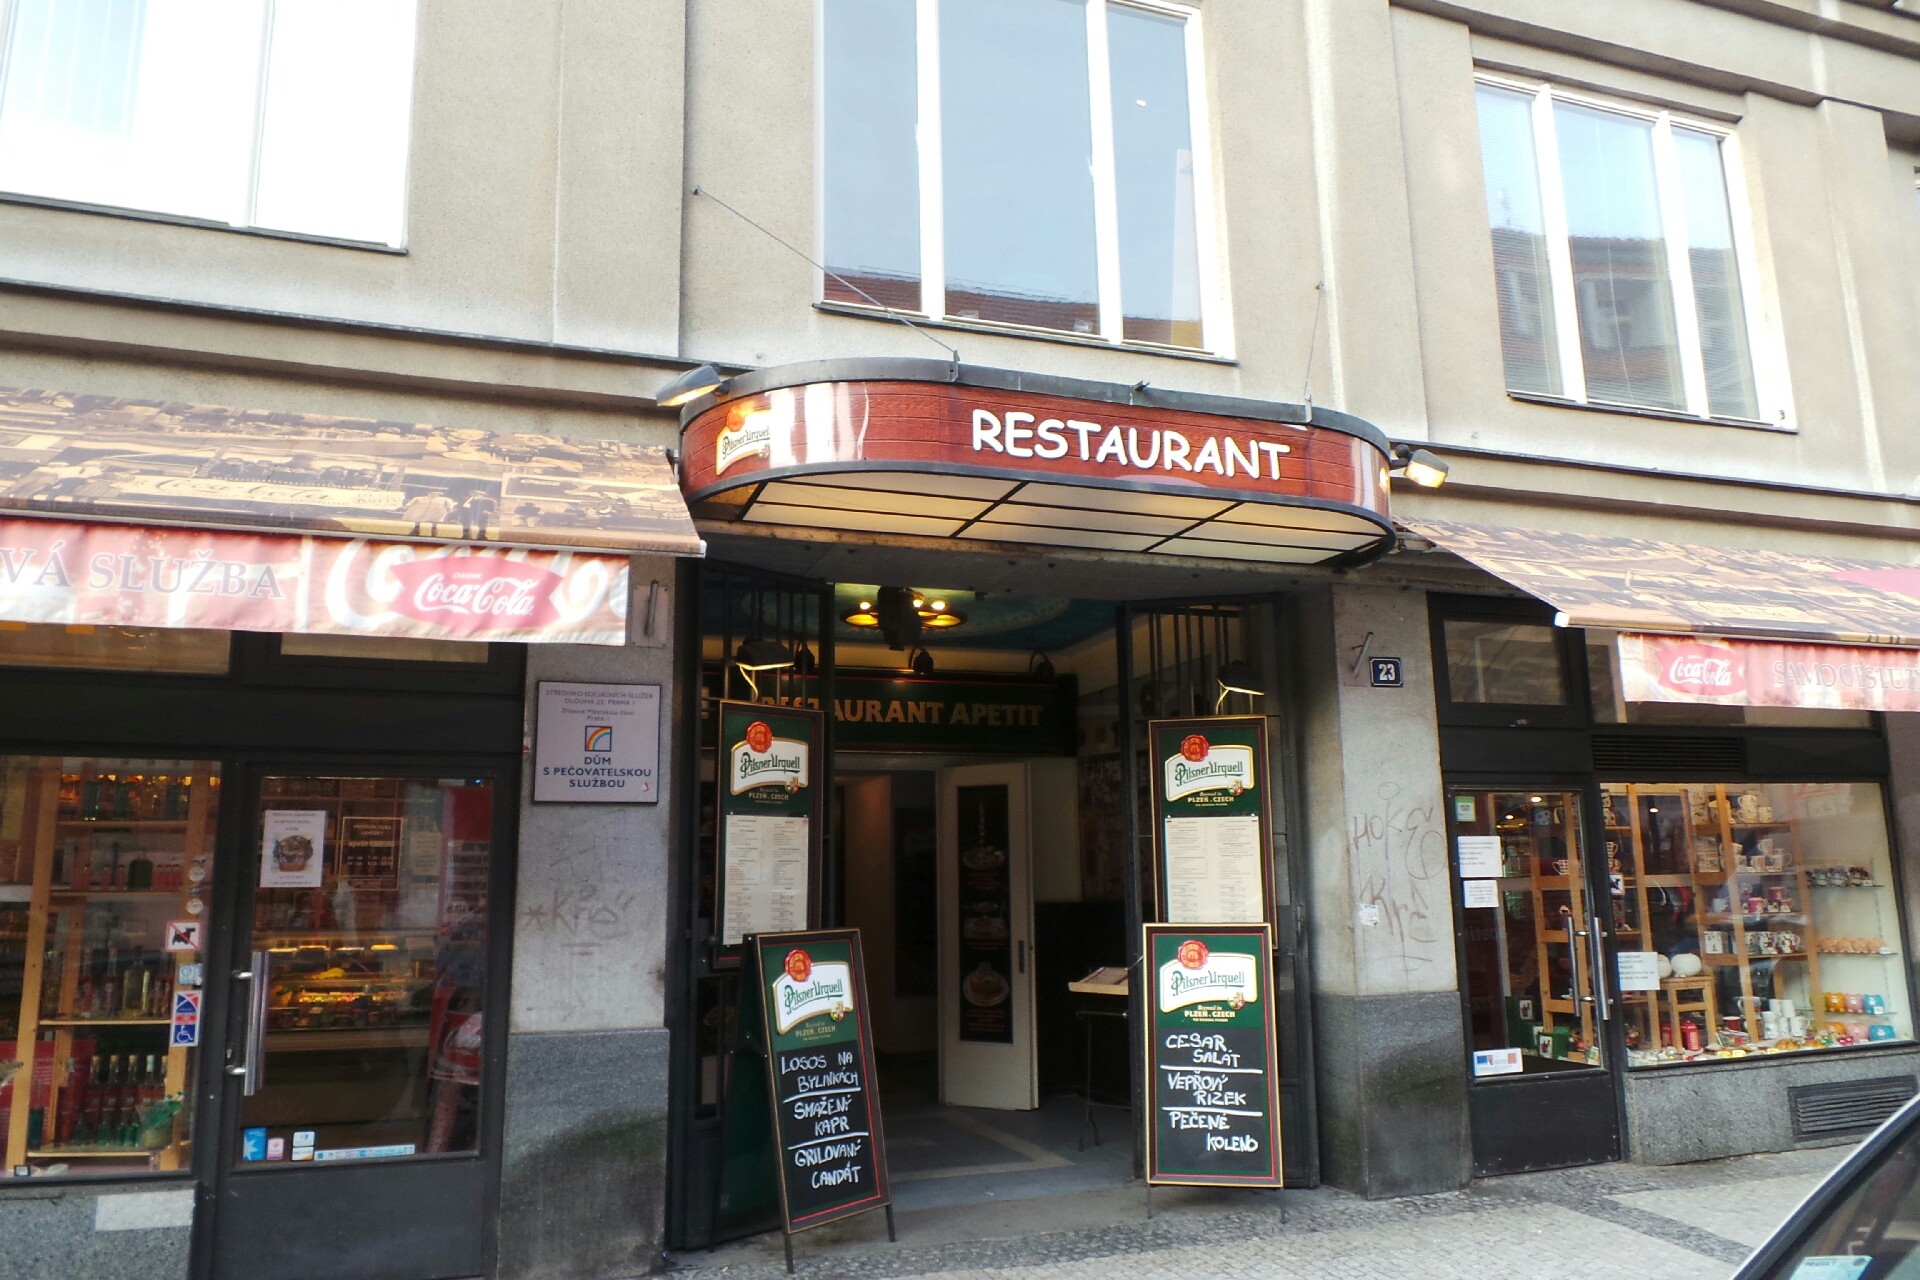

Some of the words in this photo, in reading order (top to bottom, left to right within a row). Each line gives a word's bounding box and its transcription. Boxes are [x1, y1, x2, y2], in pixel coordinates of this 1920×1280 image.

[744, 425, 771, 442] Urquel
[972, 408, 1291, 481] RESTAURANT
[88, 549, 283, 599] SLUŽBA
[413, 572, 541, 616] Coca-Cola
[1378, 663, 1396, 681] 23
[950, 703, 1043, 727] APETIT
[543, 767, 550, 776] S
[553, 766, 651, 777] PEČOVATELSKOU
[584, 755, 611, 765] DŮM
[740, 752, 771, 779] Pilsner
[770, 753, 800, 774] Urquell
[569, 778, 625, 788] SLUŽBOU
[1174, 762, 1210, 787] Pilsner
[1209, 761, 1243, 777] Urquell
[1170, 970, 1209, 997] Pilsner
[1208, 970, 1245, 988] Urquell
[784, 984, 814, 1015] Pilsner
[813, 979, 843, 1000] Urquell
[1212, 1010, 1236, 1018] CZECH
[1165, 1033, 1227, 1052] CESAR
[781, 1055, 827, 1075] LOSOS
[837, 1051, 853, 1066] NA
[1192, 1049, 1240, 1068] SALÁT
[797, 1066, 859, 1093] BYLINKÁCH
[1167, 1070, 1228, 1092] VEPŘOVÝ
[794, 1094, 852, 1120] SMAŽENÝ
[814, 1115, 850, 1137] KAPR
[1169, 1110, 1230, 1130] PEČENÉ
[795, 1138, 861, 1167] GRILOVANÝ
[811, 1161, 861, 1189] CANDÁT
